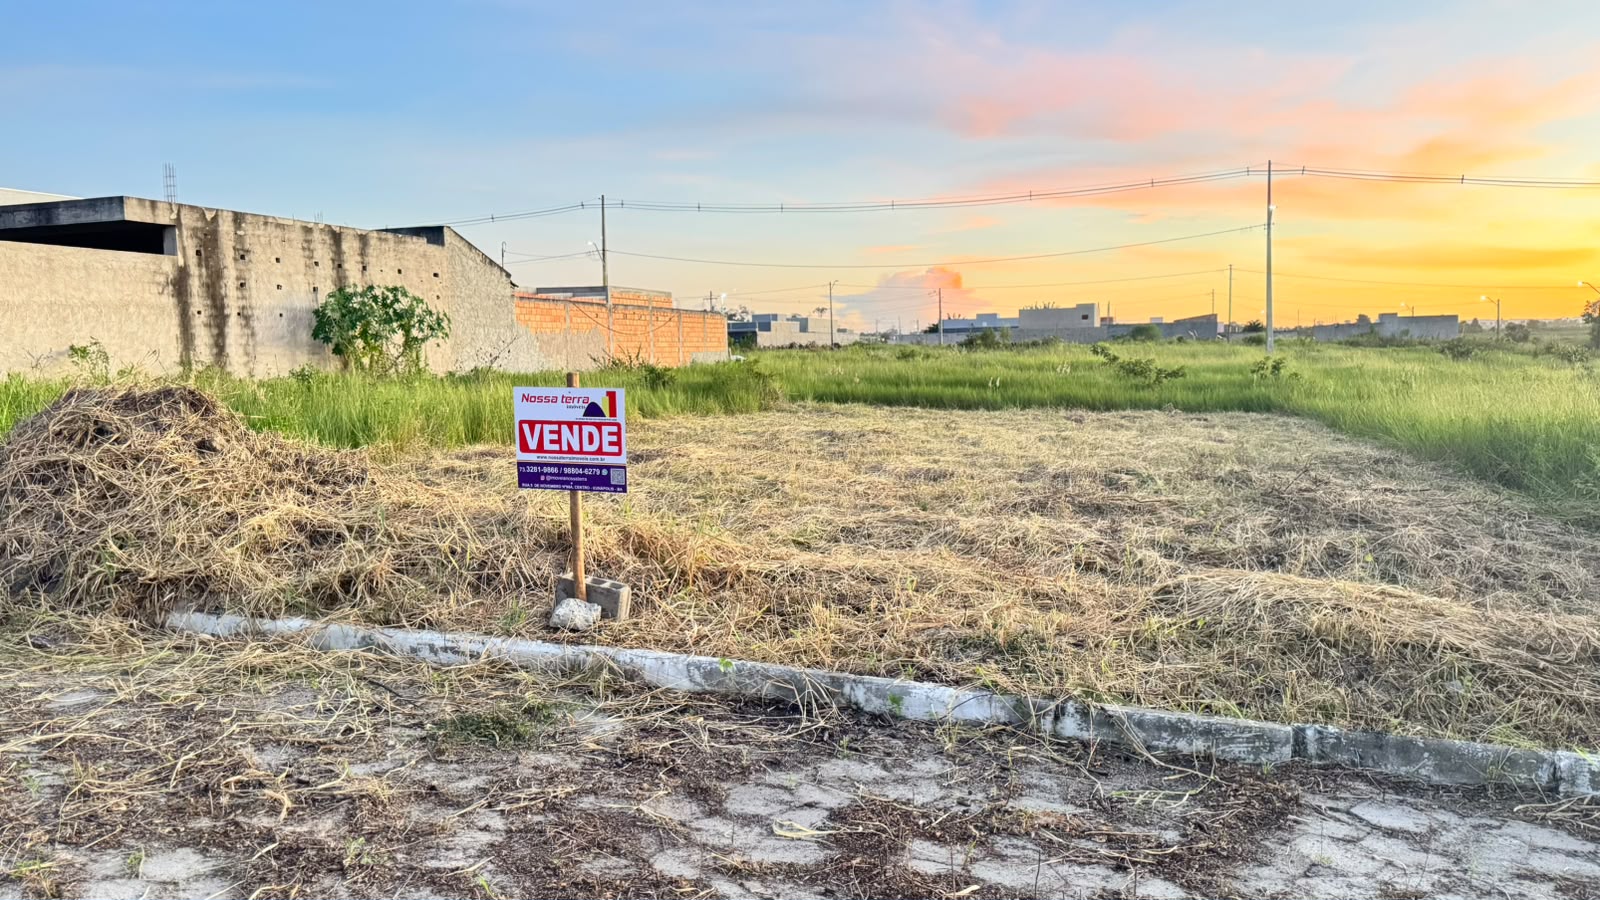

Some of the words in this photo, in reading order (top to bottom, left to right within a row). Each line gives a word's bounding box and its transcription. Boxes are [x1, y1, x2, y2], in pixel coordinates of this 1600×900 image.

[521, 393, 558, 403] Nossa
[561, 394, 590, 404] terra
[521, 423, 619, 453] VENDE
